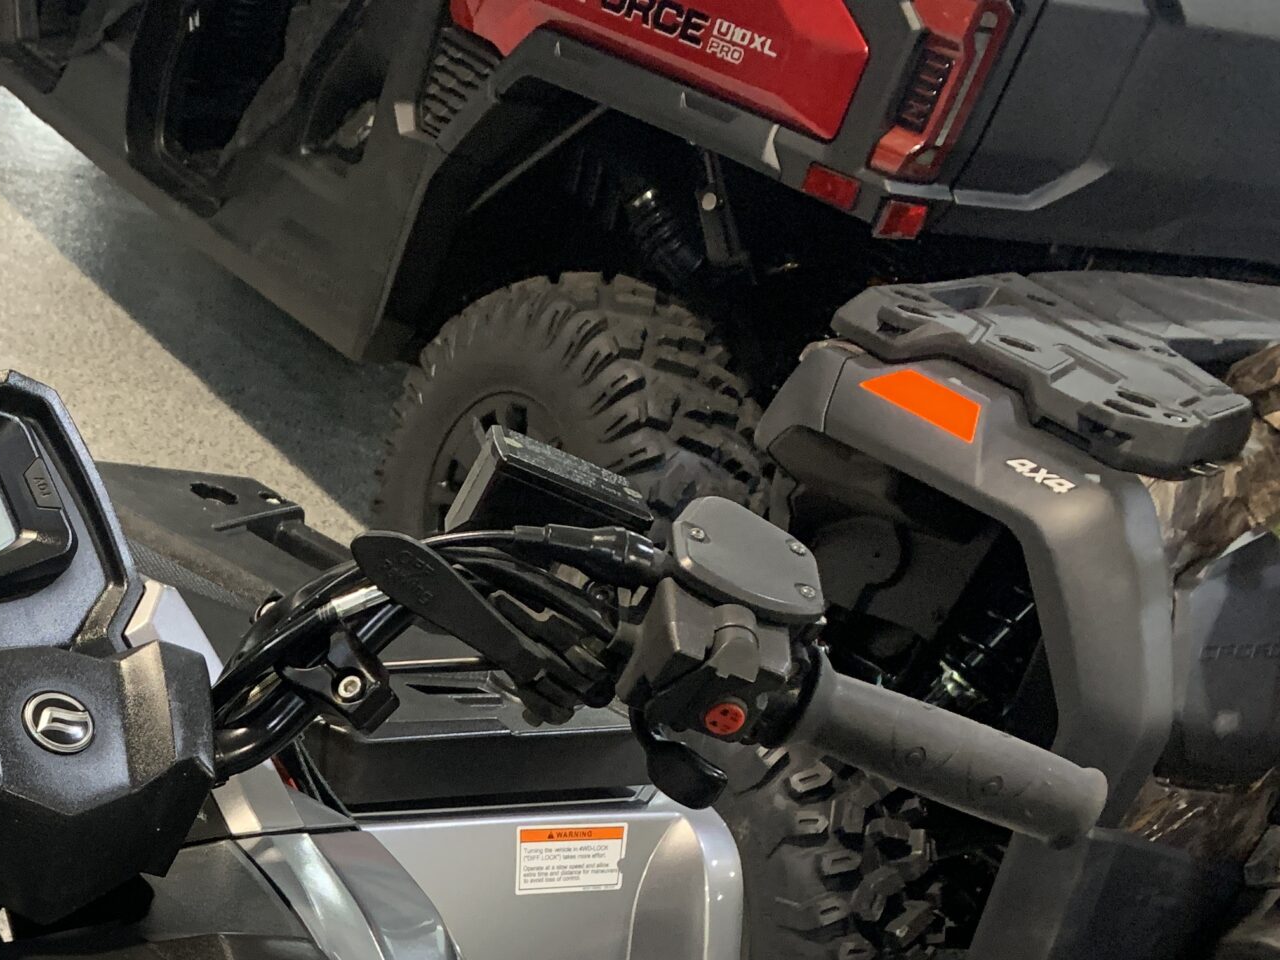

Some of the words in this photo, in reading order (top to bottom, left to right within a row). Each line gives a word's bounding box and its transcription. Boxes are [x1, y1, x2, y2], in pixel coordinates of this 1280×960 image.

[558, 0, 712, 48] RCE
[750, 33, 776, 57] XL
[707, 38, 744, 64] PRO
